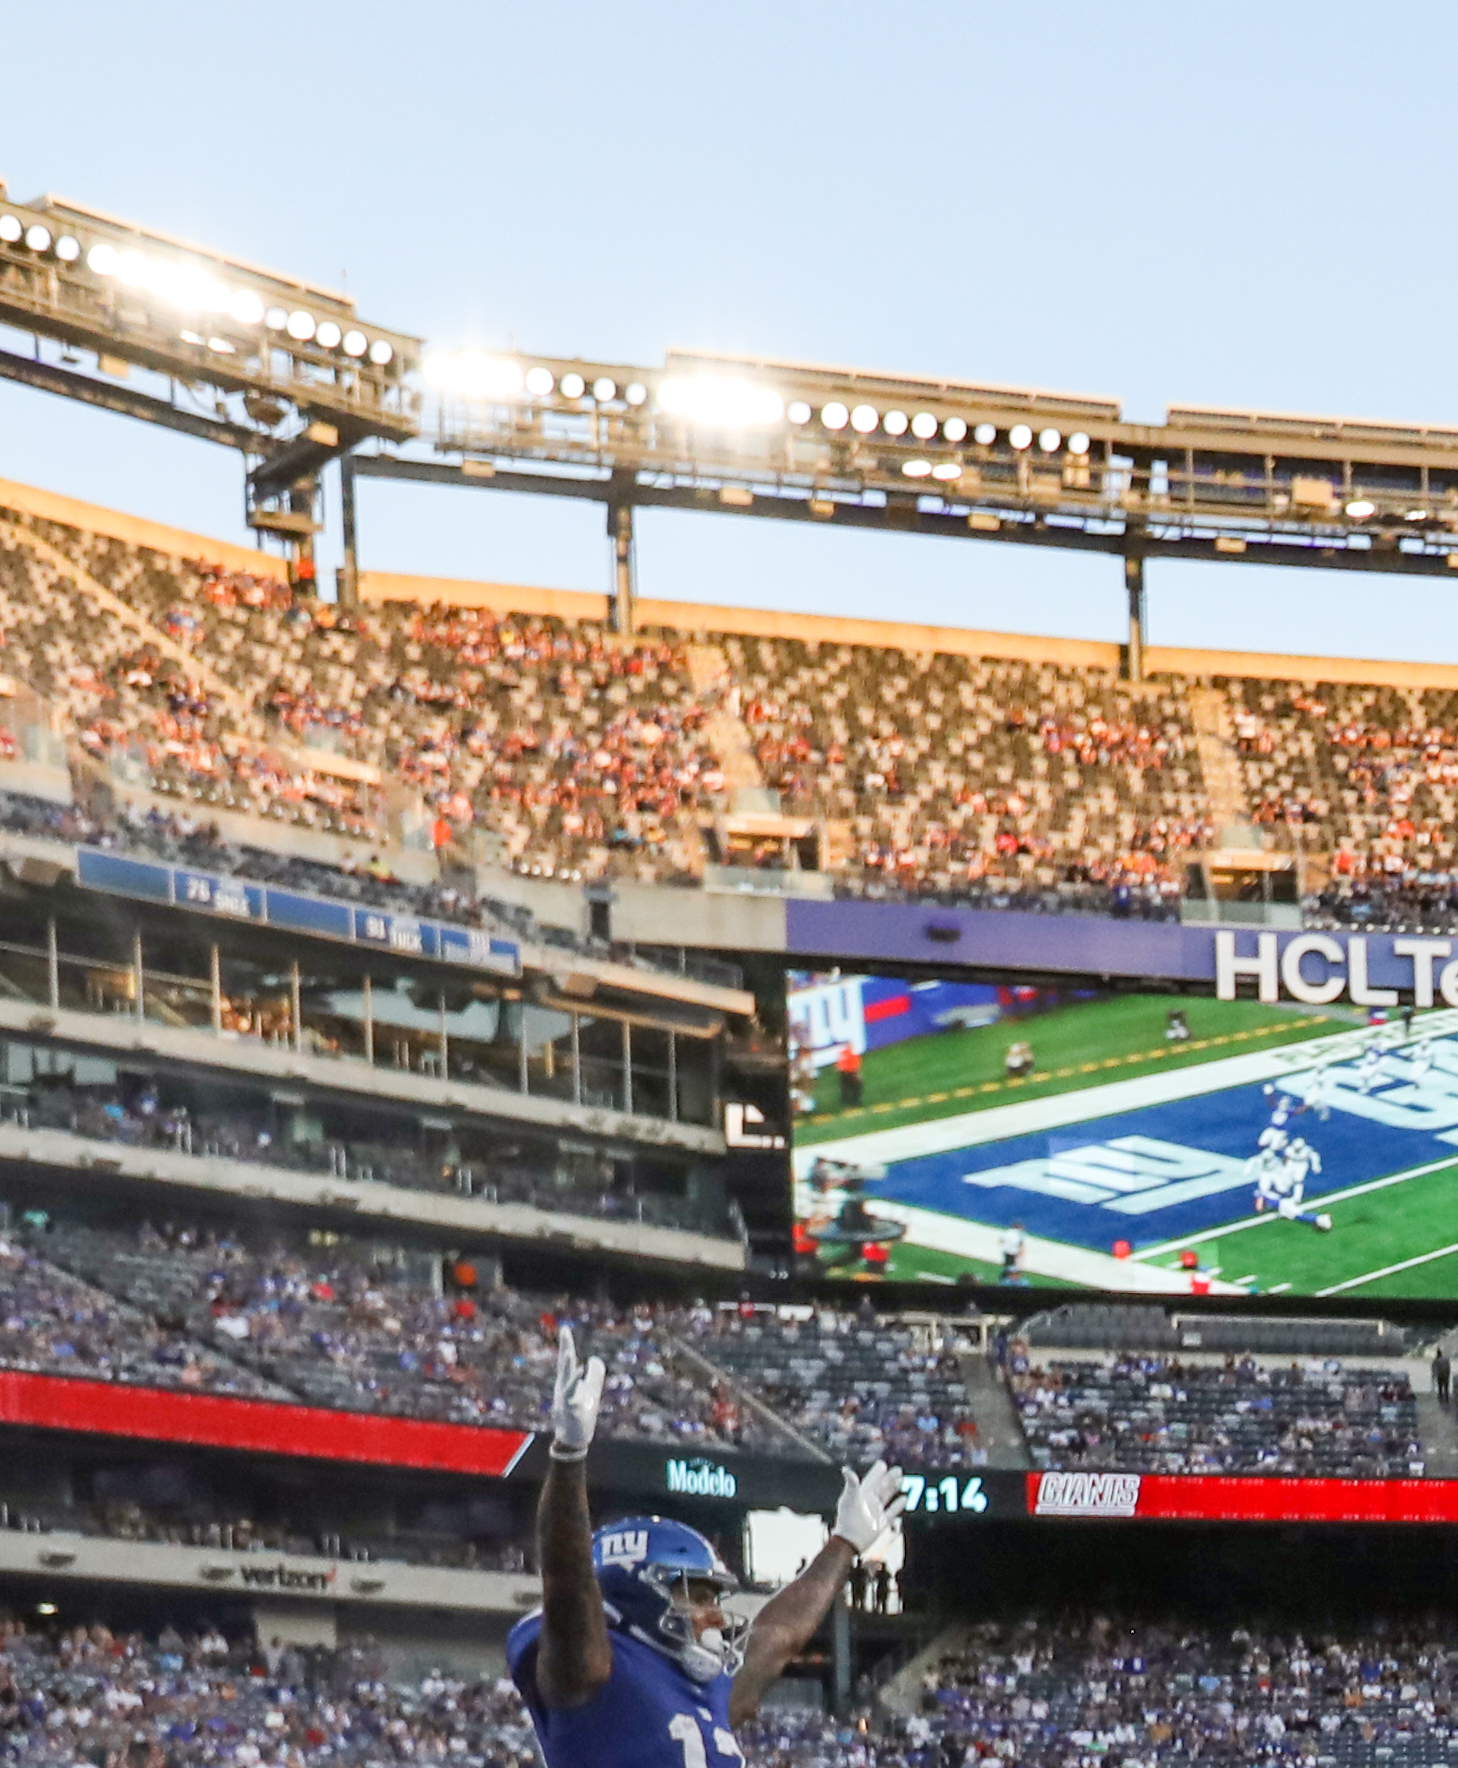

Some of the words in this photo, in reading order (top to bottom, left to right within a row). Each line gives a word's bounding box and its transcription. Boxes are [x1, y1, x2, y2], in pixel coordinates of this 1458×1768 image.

[667, 1459, 737, 1498] Modelo
[1035, 1471, 1141, 1517] GIANTS
[240, 1562, 329, 1592] verizon
